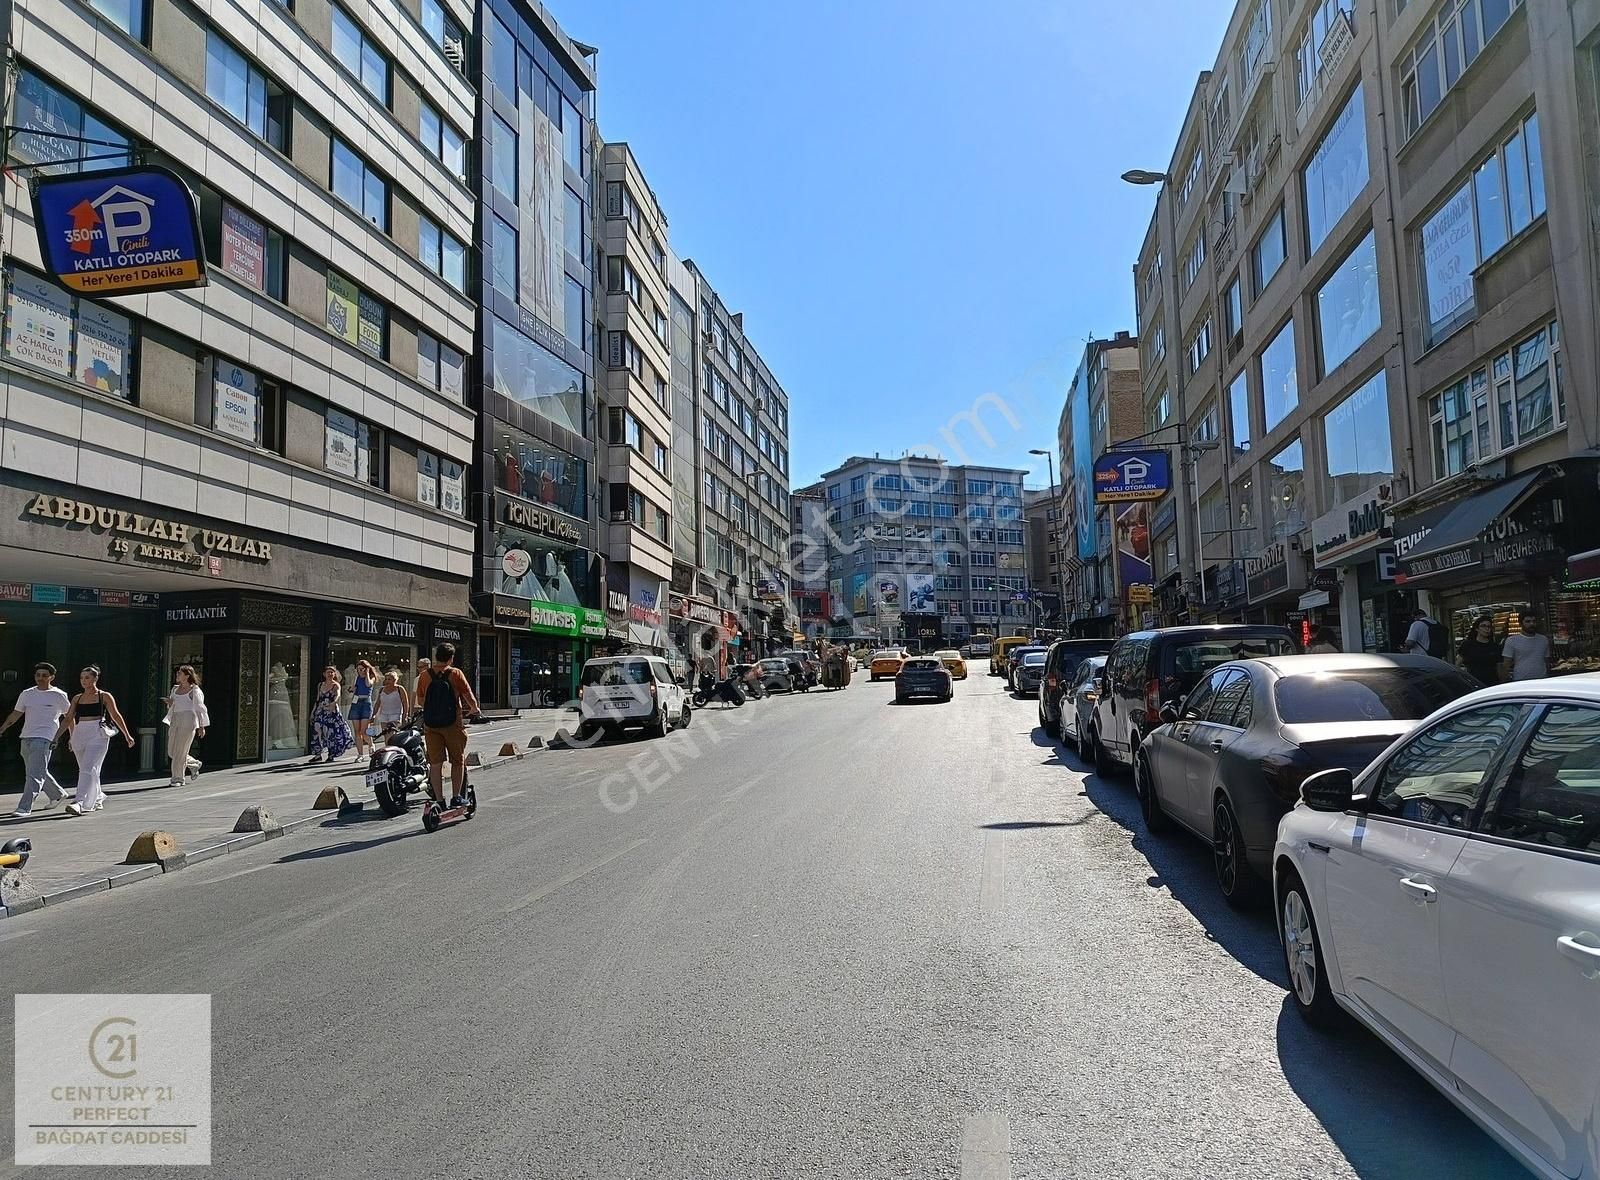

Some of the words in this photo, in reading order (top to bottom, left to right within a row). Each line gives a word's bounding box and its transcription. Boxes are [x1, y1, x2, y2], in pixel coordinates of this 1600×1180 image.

[31, 137, 57, 158] HUKUK
[64, 227, 104, 243] 350m
[120, 237, 150, 256] Çinili
[74, 257, 113, 271] KATLI
[117, 249, 181, 268] OTOPARK
[82, 272, 104, 287] Her
[105, 270, 132, 284] Yere
[134, 271, 140, 282] 1
[141, 267, 184, 281] Dakika
[363, 326, 378, 342] FOTO
[16, 334, 28, 344] AZ
[30, 339, 64, 358] HARCAR
[226, 387, 248, 402] Canon
[225, 400, 247, 415] EPSON
[28, 493, 191, 544] ABDULLAH
[202, 529, 274, 561] UZLAR
[114, 536, 129, 555] İŞ
[345, 614, 378, 634] BUTİK
[385, 619, 415, 638] ANTİK
